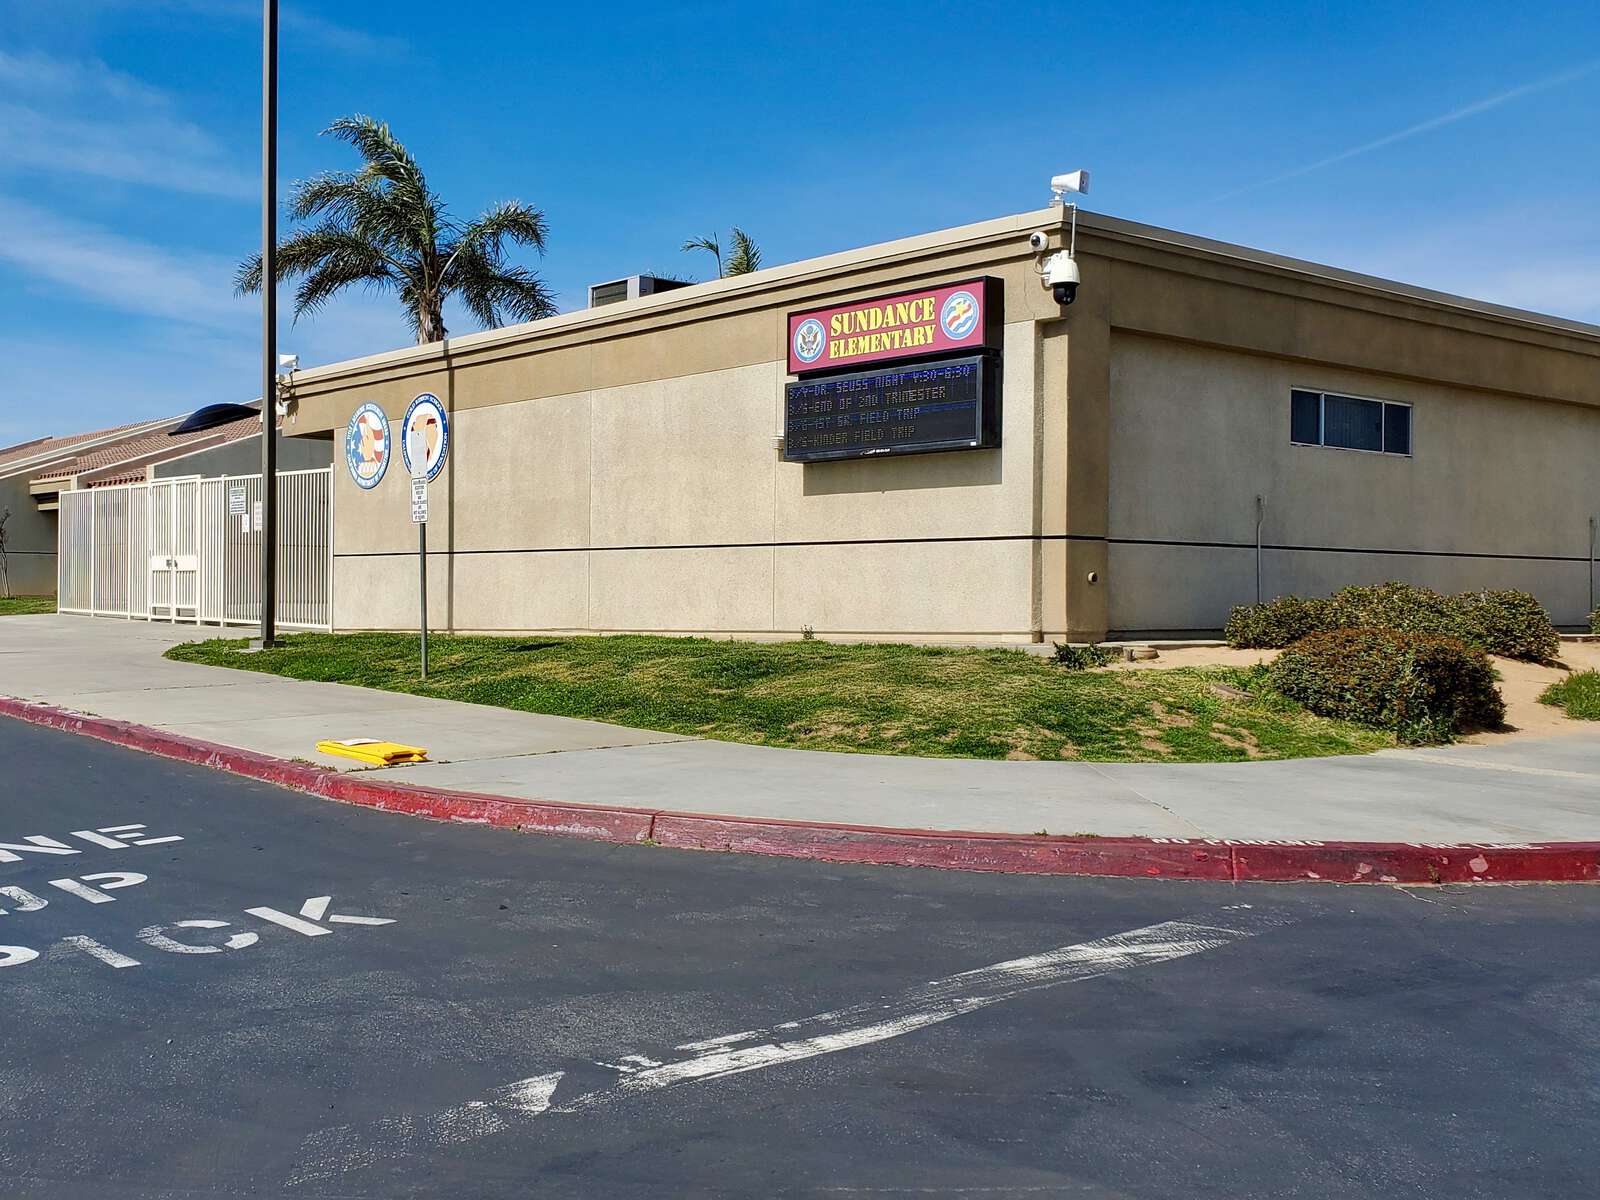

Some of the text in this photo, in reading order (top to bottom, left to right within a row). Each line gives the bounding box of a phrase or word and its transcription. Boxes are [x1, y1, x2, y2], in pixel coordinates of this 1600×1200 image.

[830, 297, 936, 337] SUNDANCE
[828, 324, 937, 359] ELEMENTARY
[836, 379, 868, 393] SEUSS
[875, 373, 906, 388] NIGHT
[839, 397, 852, 410] OF
[885, 385, 946, 404] TRIMESTER
[860, 410, 889, 425] FIELD
[896, 406, 920, 420] TRIP
[854, 428, 884, 442] FIELD
[892, 425, 915, 439] TRIP
